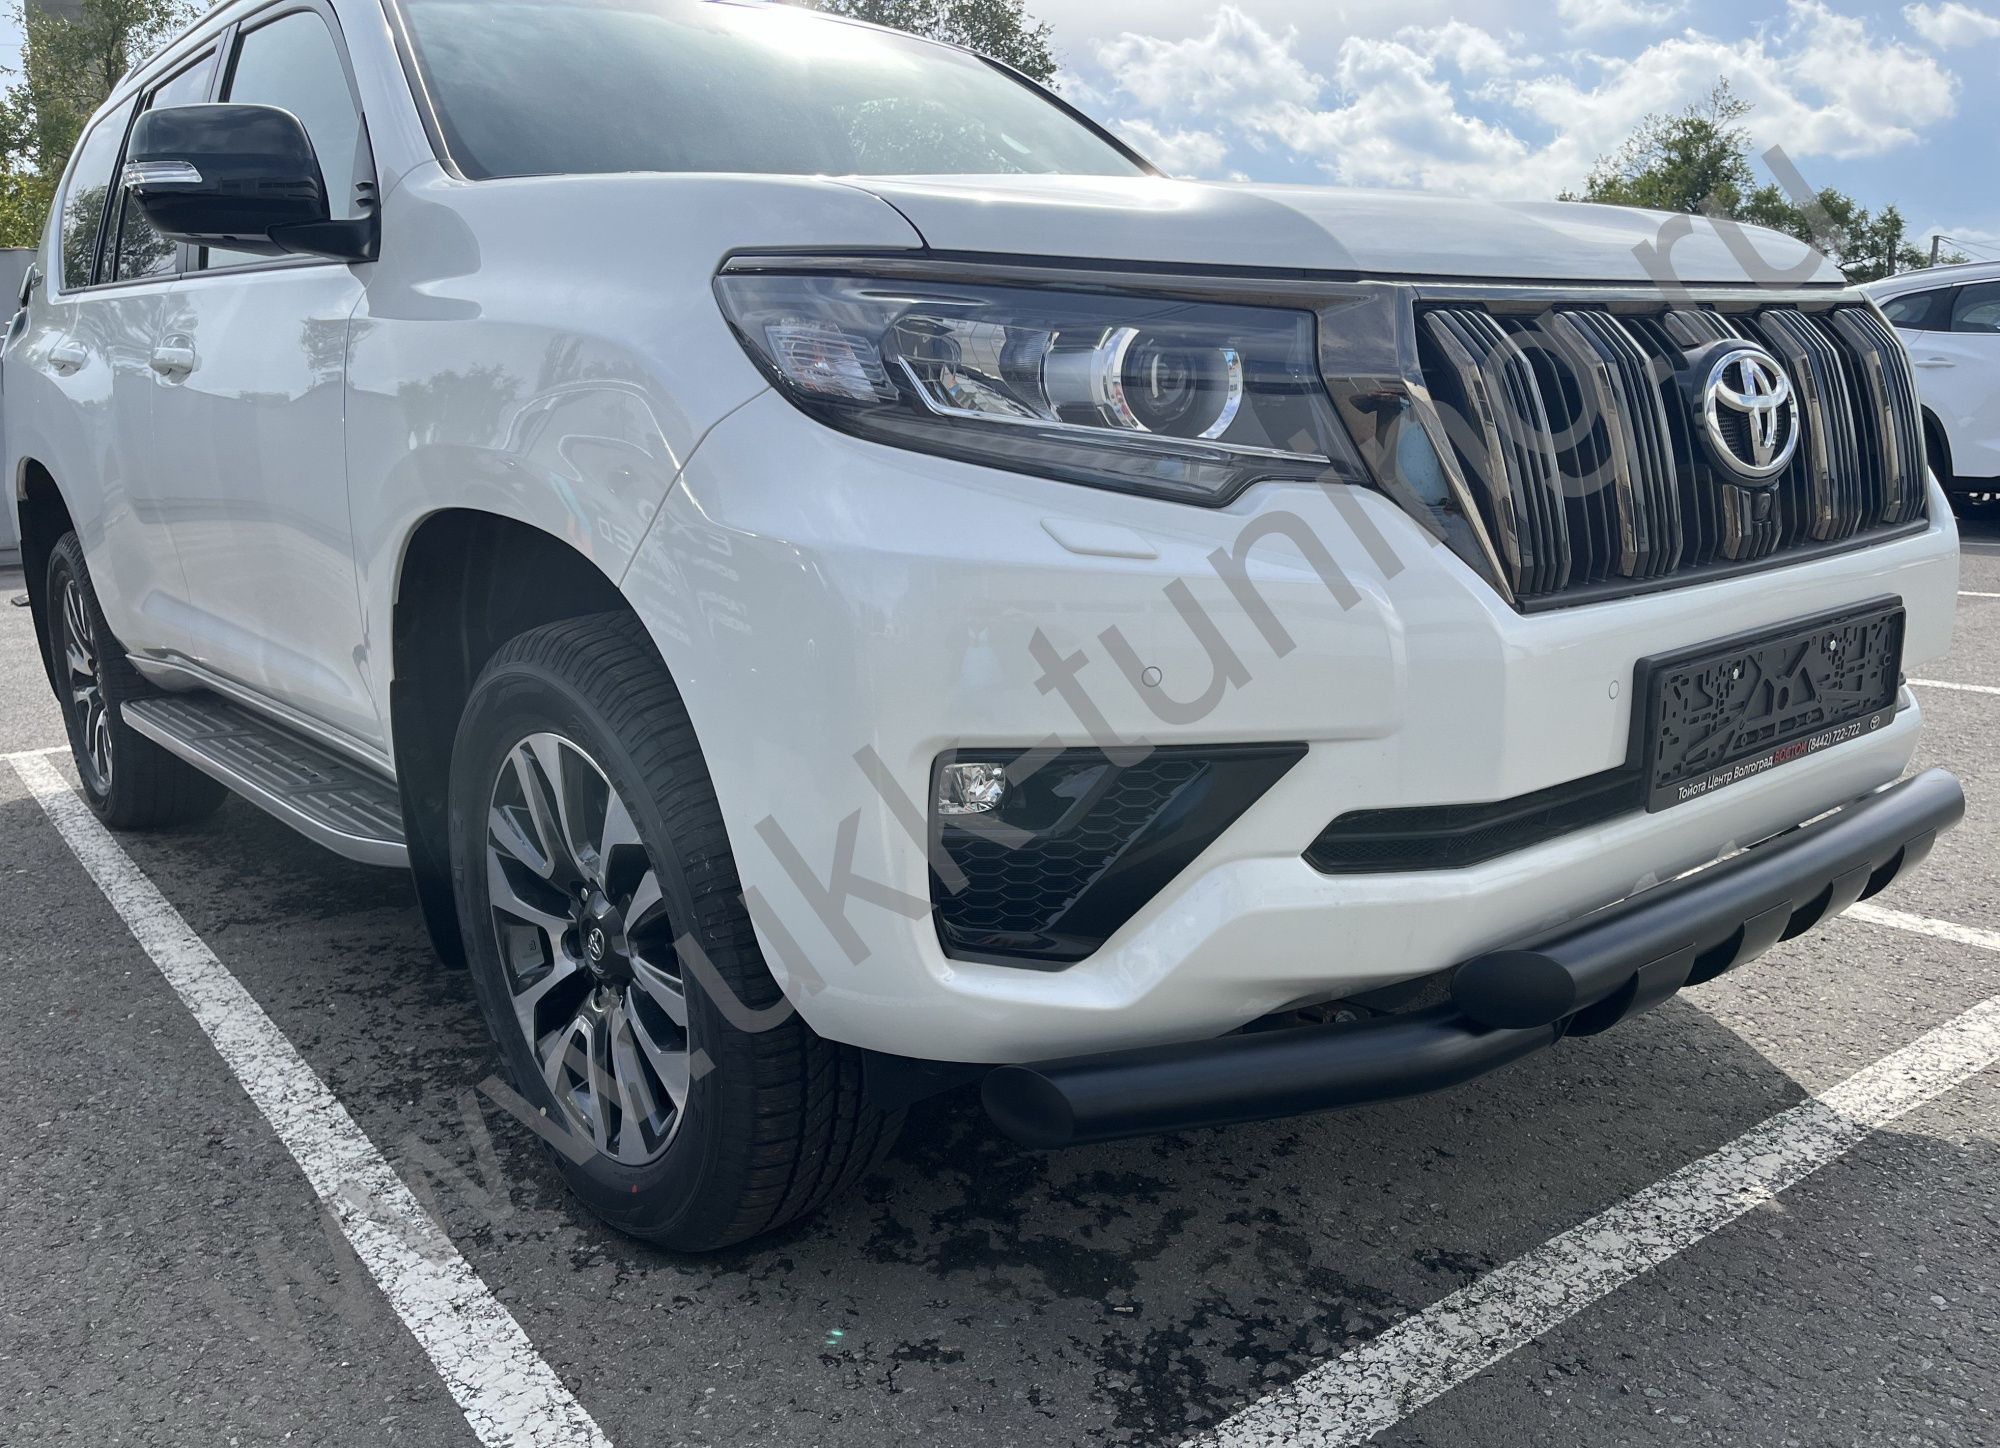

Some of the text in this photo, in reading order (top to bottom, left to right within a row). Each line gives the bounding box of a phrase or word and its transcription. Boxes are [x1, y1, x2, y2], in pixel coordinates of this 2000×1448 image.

[1678, 780, 1706, 800] Тойота
[1708, 770, 1733, 790] Центр
[1734, 755, 1773, 779] Волгоград
[1808, 732, 1832, 752] (8442)
[1832, 722, 1861, 743] 722-722
